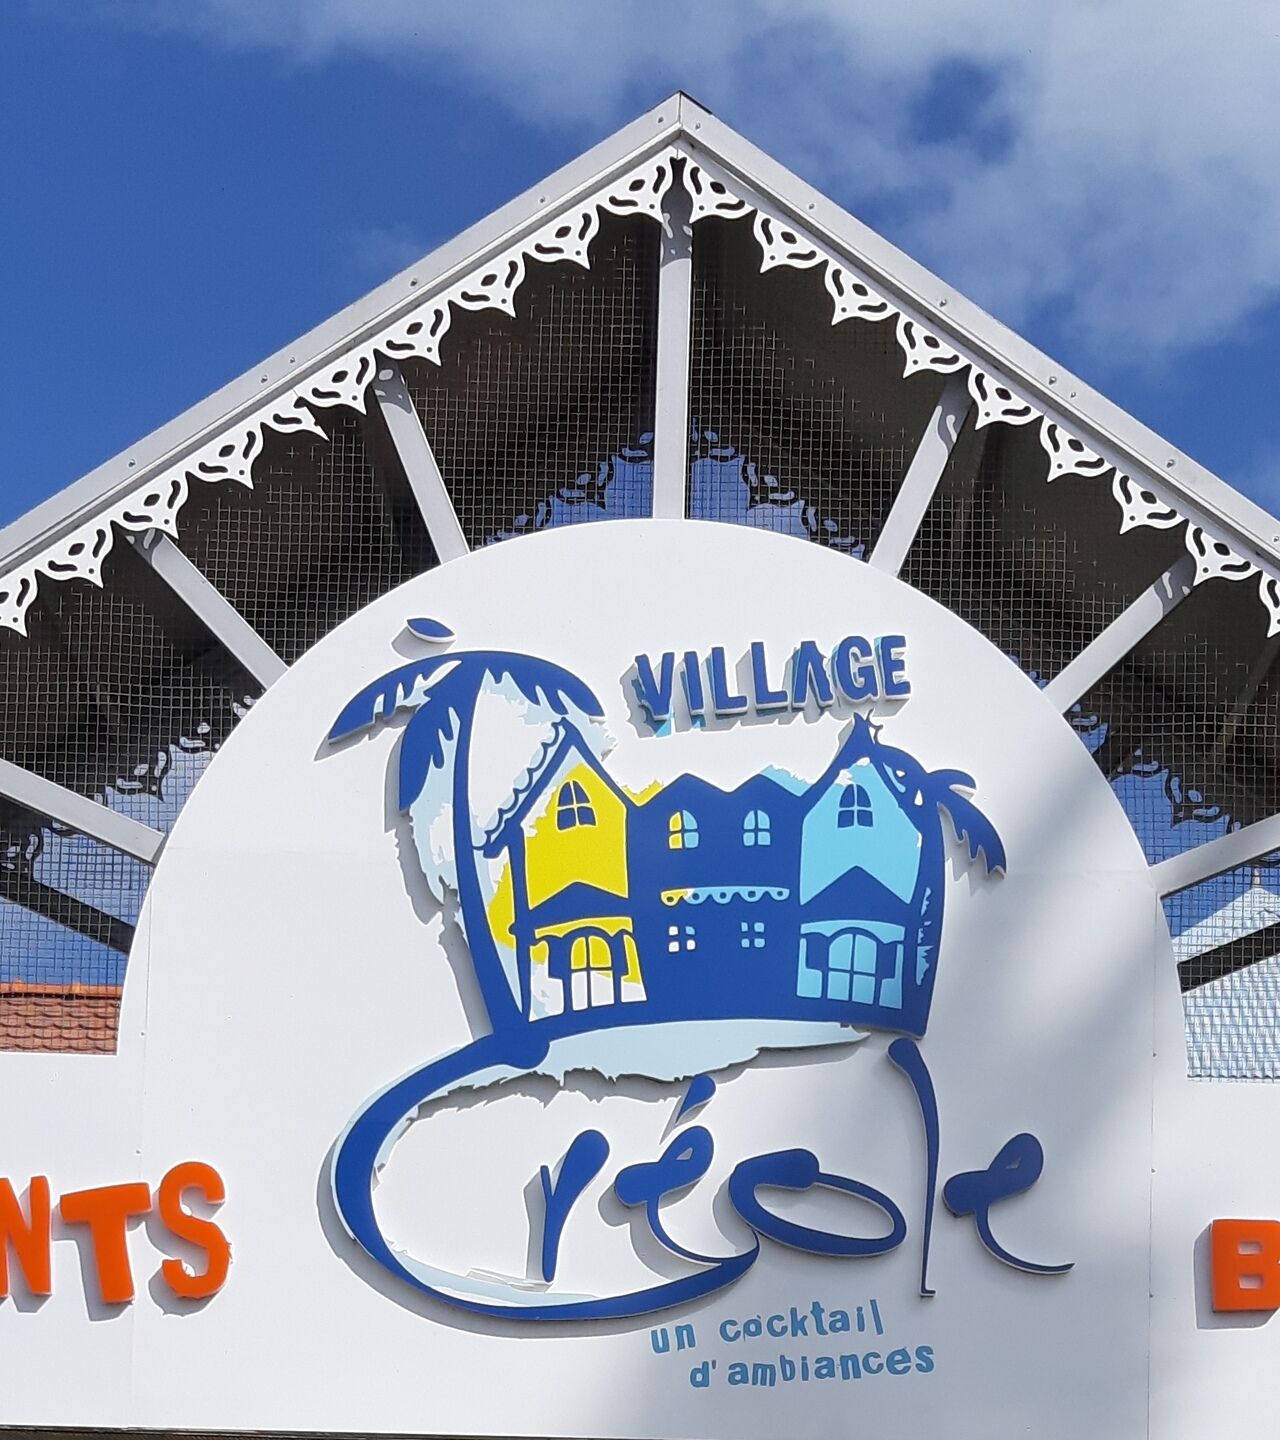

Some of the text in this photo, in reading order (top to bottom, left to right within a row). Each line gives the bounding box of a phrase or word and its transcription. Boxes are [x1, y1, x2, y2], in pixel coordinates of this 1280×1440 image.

[634, 634, 911, 720] VILLAGE
[332, 1031, 1074, 1320] Créole
[651, 1299, 884, 1354] un cocktail
[689, 1345, 935, 1387] d'ambiances
